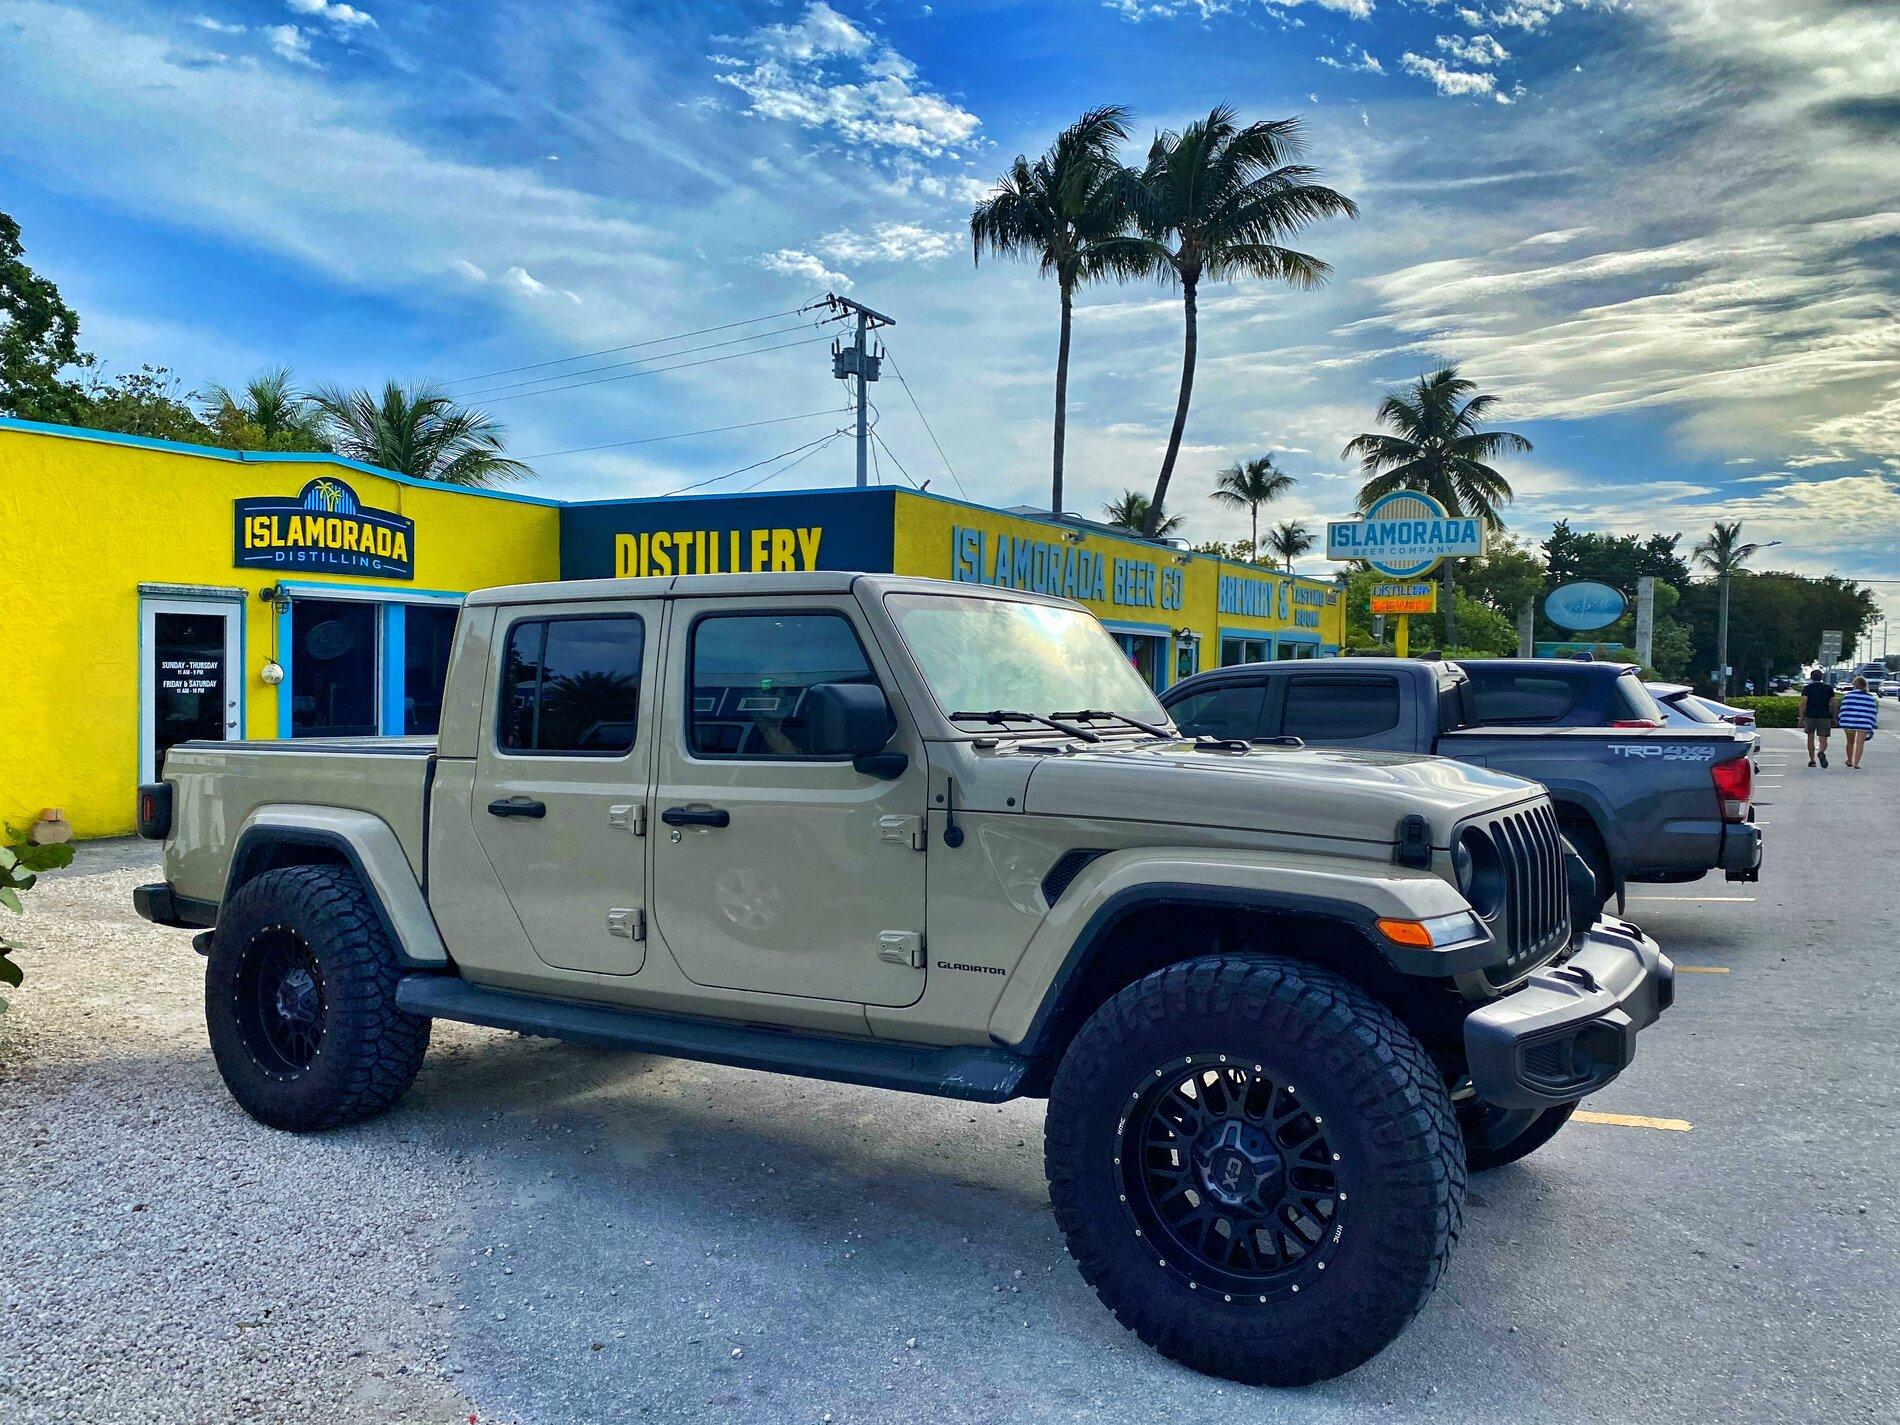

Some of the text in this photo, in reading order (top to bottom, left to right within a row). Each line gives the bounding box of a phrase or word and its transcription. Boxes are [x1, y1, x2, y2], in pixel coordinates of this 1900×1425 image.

[244, 515, 408, 563] ISLAMORADA
[1331, 520, 1477, 547] ISLAMORADA
[615, 527, 823, 579] DISTILLERY
[1353, 545, 1455, 556] BEER COMPANY
[275, 551, 382, 570] DISTILLING
[952, 525, 1183, 610] ISLAMORADA BEER CO
[1218, 575, 1326, 620] BREWERY & TASTING
[1373, 585, 1430, 596] DISTILLERY
[1295, 609, 1319, 627] ROOM
[162, 661, 186, 669] SUNDAY
[189, 661, 218, 669] THURSDAY
[163, 680, 183, 688] FRIDAY
[189, 680, 217, 688] SATURDAY
[1607, 744, 1663, 758] TRD
[937, 961, 1007, 976] GLADIATOR
